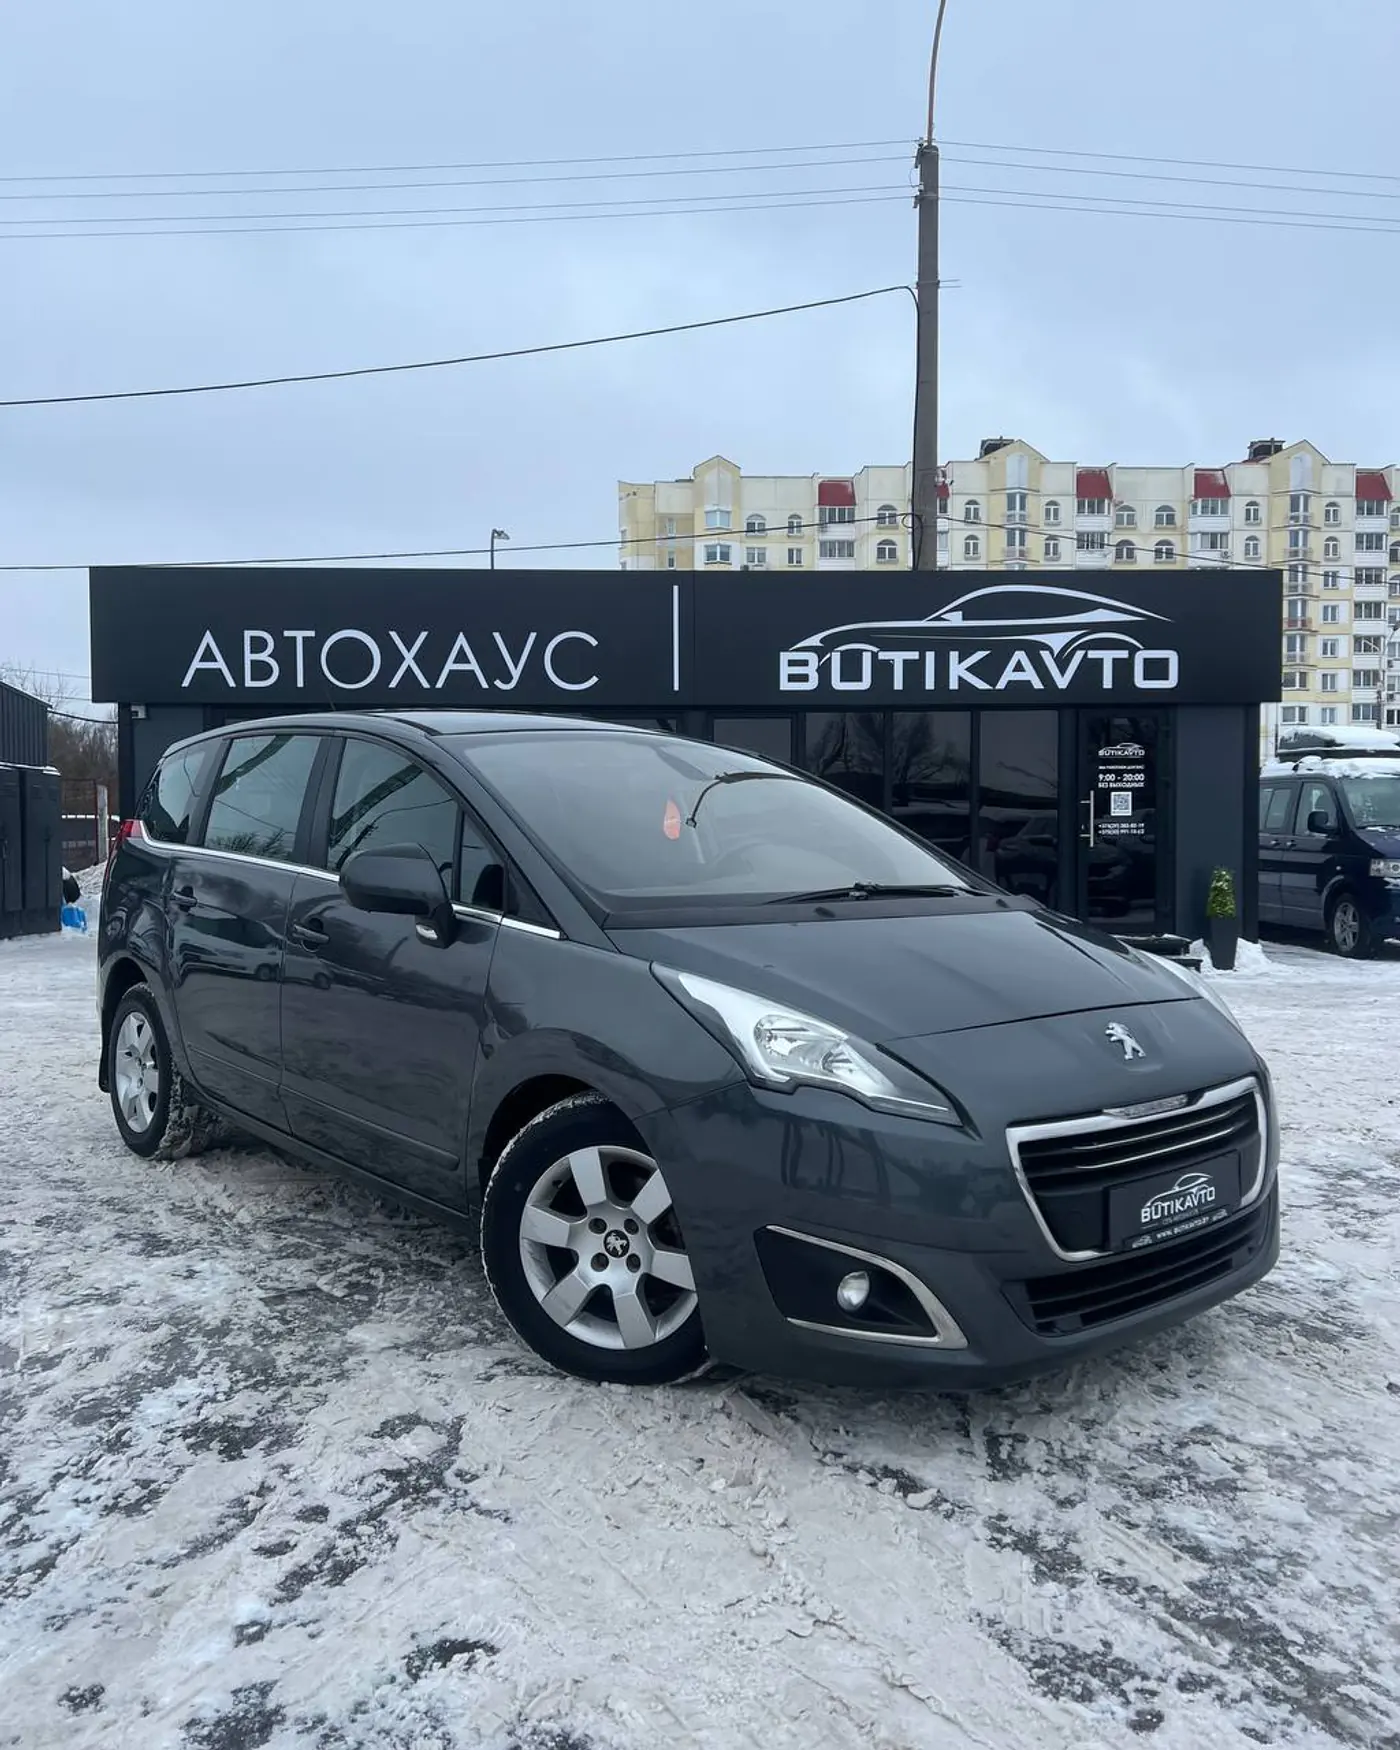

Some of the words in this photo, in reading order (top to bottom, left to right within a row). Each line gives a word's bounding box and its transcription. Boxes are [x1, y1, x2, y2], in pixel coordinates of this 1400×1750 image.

[181, 628, 600, 691] АВТОХАУС
[779, 649, 1179, 691] BUTIKAVTO
[1098, 773, 1116, 781] 9:00
[1122, 773, 1145, 781] 20:00
[1141, 1186, 1216, 1223] BUTIKAVTO
